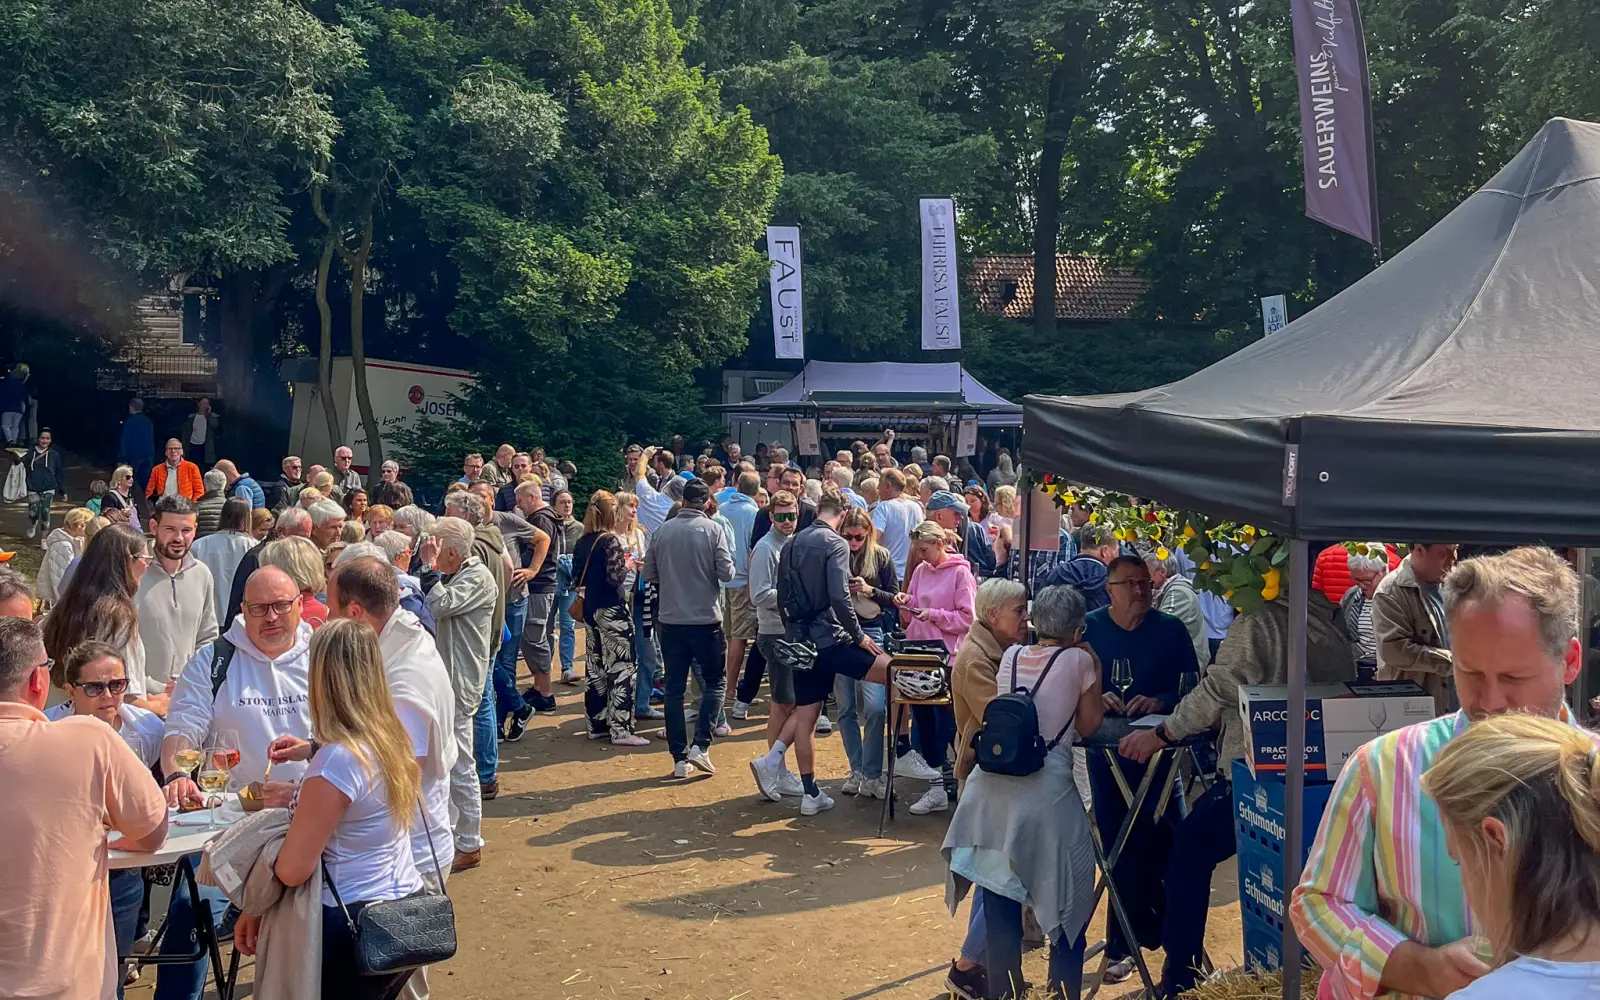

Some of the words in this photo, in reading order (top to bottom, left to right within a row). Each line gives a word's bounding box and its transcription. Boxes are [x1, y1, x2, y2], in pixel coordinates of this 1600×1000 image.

[1310, 52, 1337, 189] SAUERWEINS
[933, 223, 948, 293] THERESA
[775, 240, 796, 342] FAUST
[934, 298, 950, 344] FAUST
[382, 415, 406, 426] kann
[1286, 452, 1296, 498] TOOLPORT
[239, 696, 274, 706] STONE
[278, 694, 309, 705] ISLAN
[262, 707, 297, 717] MARINA
[1239, 801, 1286, 841] Schumacher
[1244, 877, 1285, 917] Schumach
